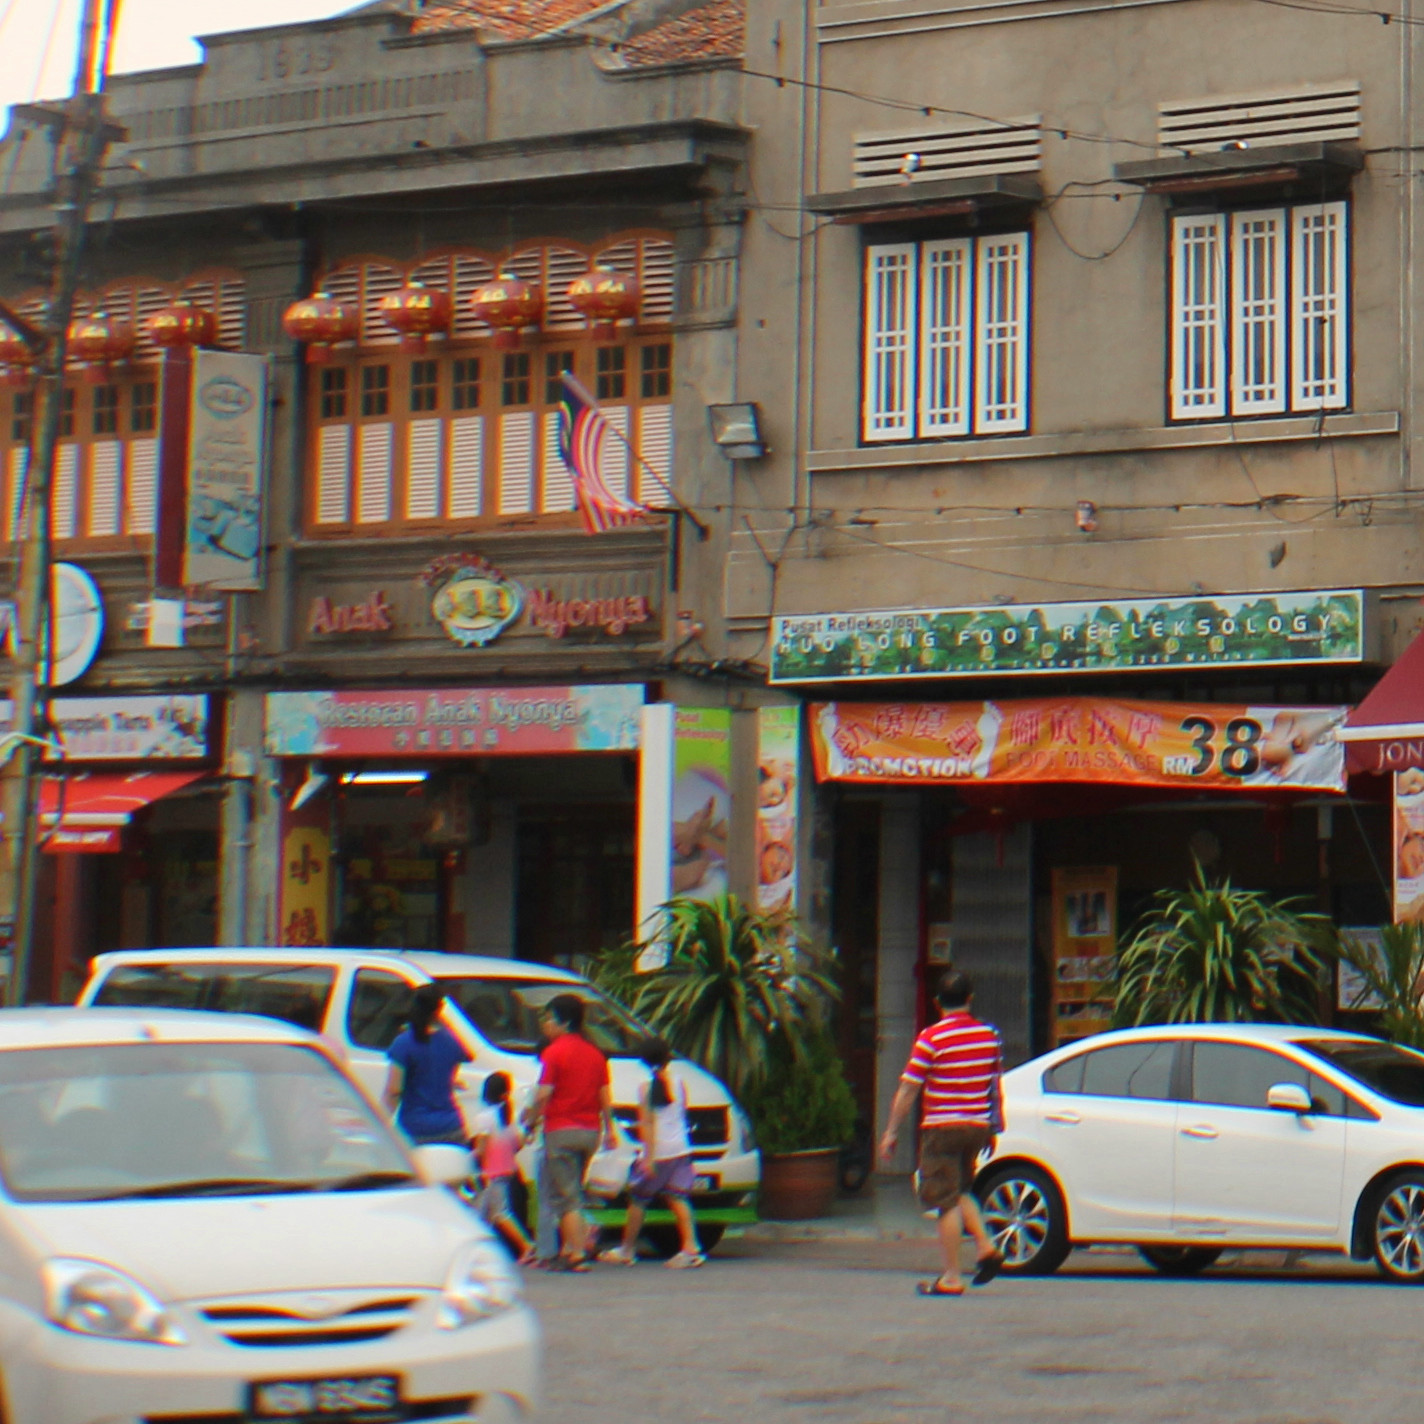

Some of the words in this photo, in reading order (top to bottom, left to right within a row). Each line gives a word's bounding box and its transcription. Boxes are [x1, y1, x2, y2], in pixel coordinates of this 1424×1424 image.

[309, 592, 392, 633] Anak
[527, 588, 647, 639] Nyonya
[781, 618, 824, 635] Pusat
[827, 614, 920, 634] Refleksologi
[778, 636, 835, 656] HUO
[855, 631, 936, 650] LONG
[957, 624, 1040, 646] FOOT
[1060, 613, 1332, 642] REFLEKSOLOGY
[424, 696, 482, 726] Anak
[488, 692, 580, 731] Nyonya
[1006, 752, 1058, 770] FOOT
[1064, 749, 1158, 772] MASSAGE
[1179, 715, 1264, 777] 38
[842, 757, 974, 778] PROMOTION
[1162, 756, 1196, 776] RM
